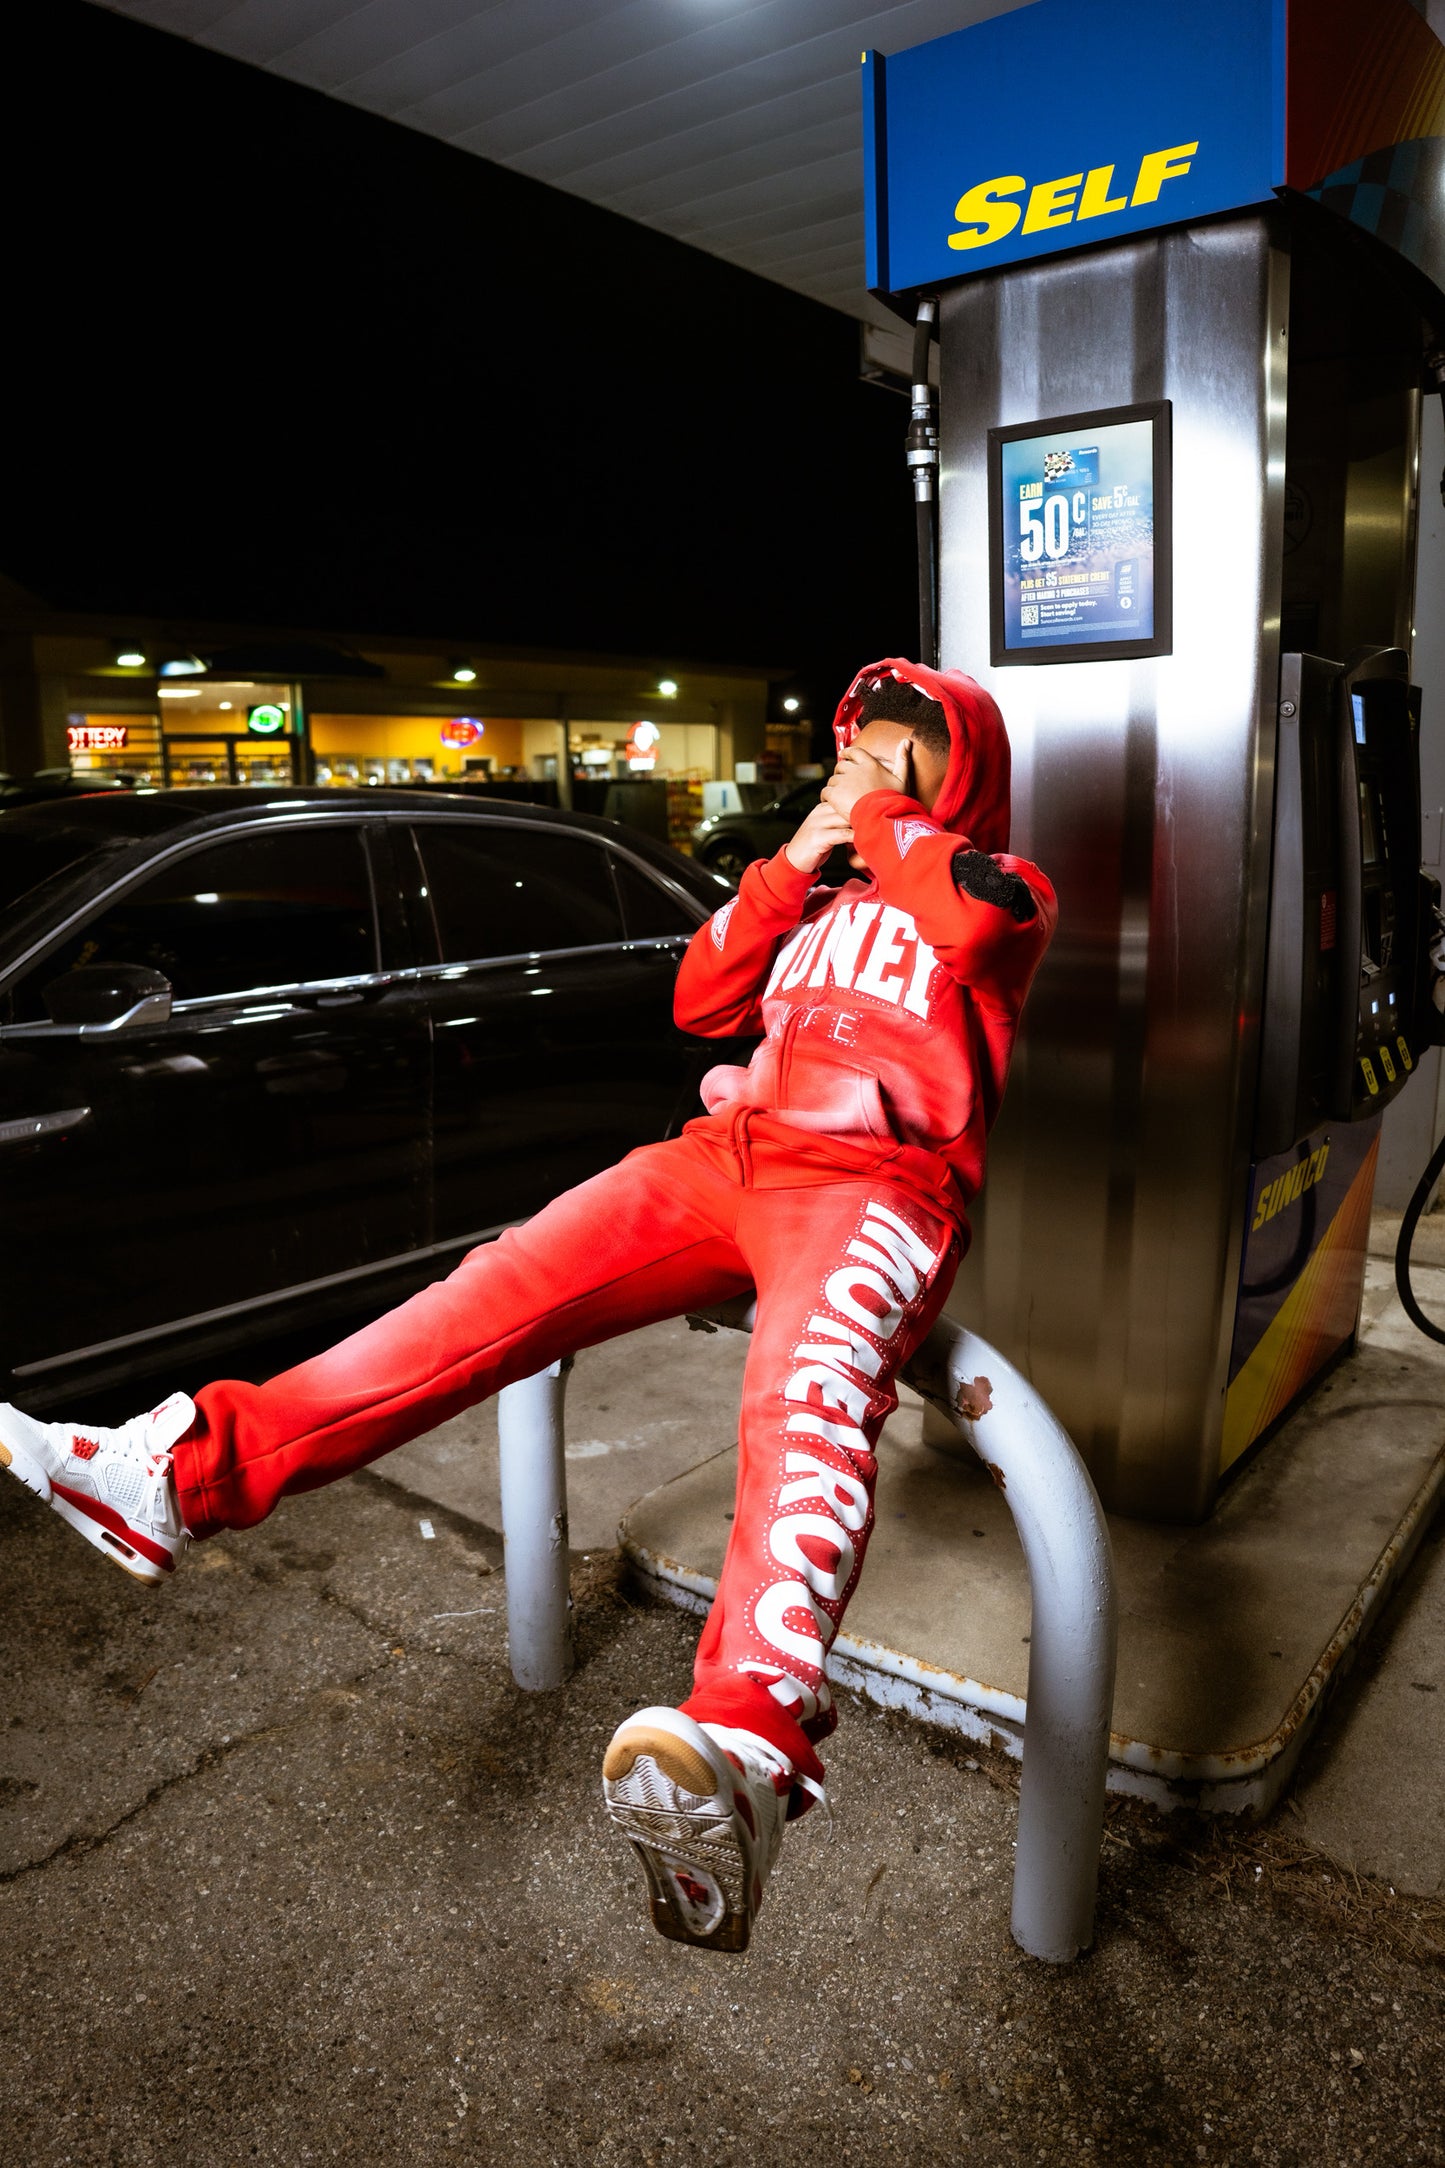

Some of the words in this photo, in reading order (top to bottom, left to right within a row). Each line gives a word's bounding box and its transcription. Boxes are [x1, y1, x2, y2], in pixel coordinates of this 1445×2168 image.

[947, 141, 1199, 251] SELF
[1019, 482, 1043, 500] EARN
[1092, 496, 1112, 511] SAVE
[1020, 579, 1035, 589] PLUS
[1035, 578, 1046, 588] GET
[1046, 571, 1058, 587] $5
[1021, 592, 1036, 602] AFTER
[1061, 601, 1078, 610] apply
[1252, 1144, 1330, 1233] SUNOCO
